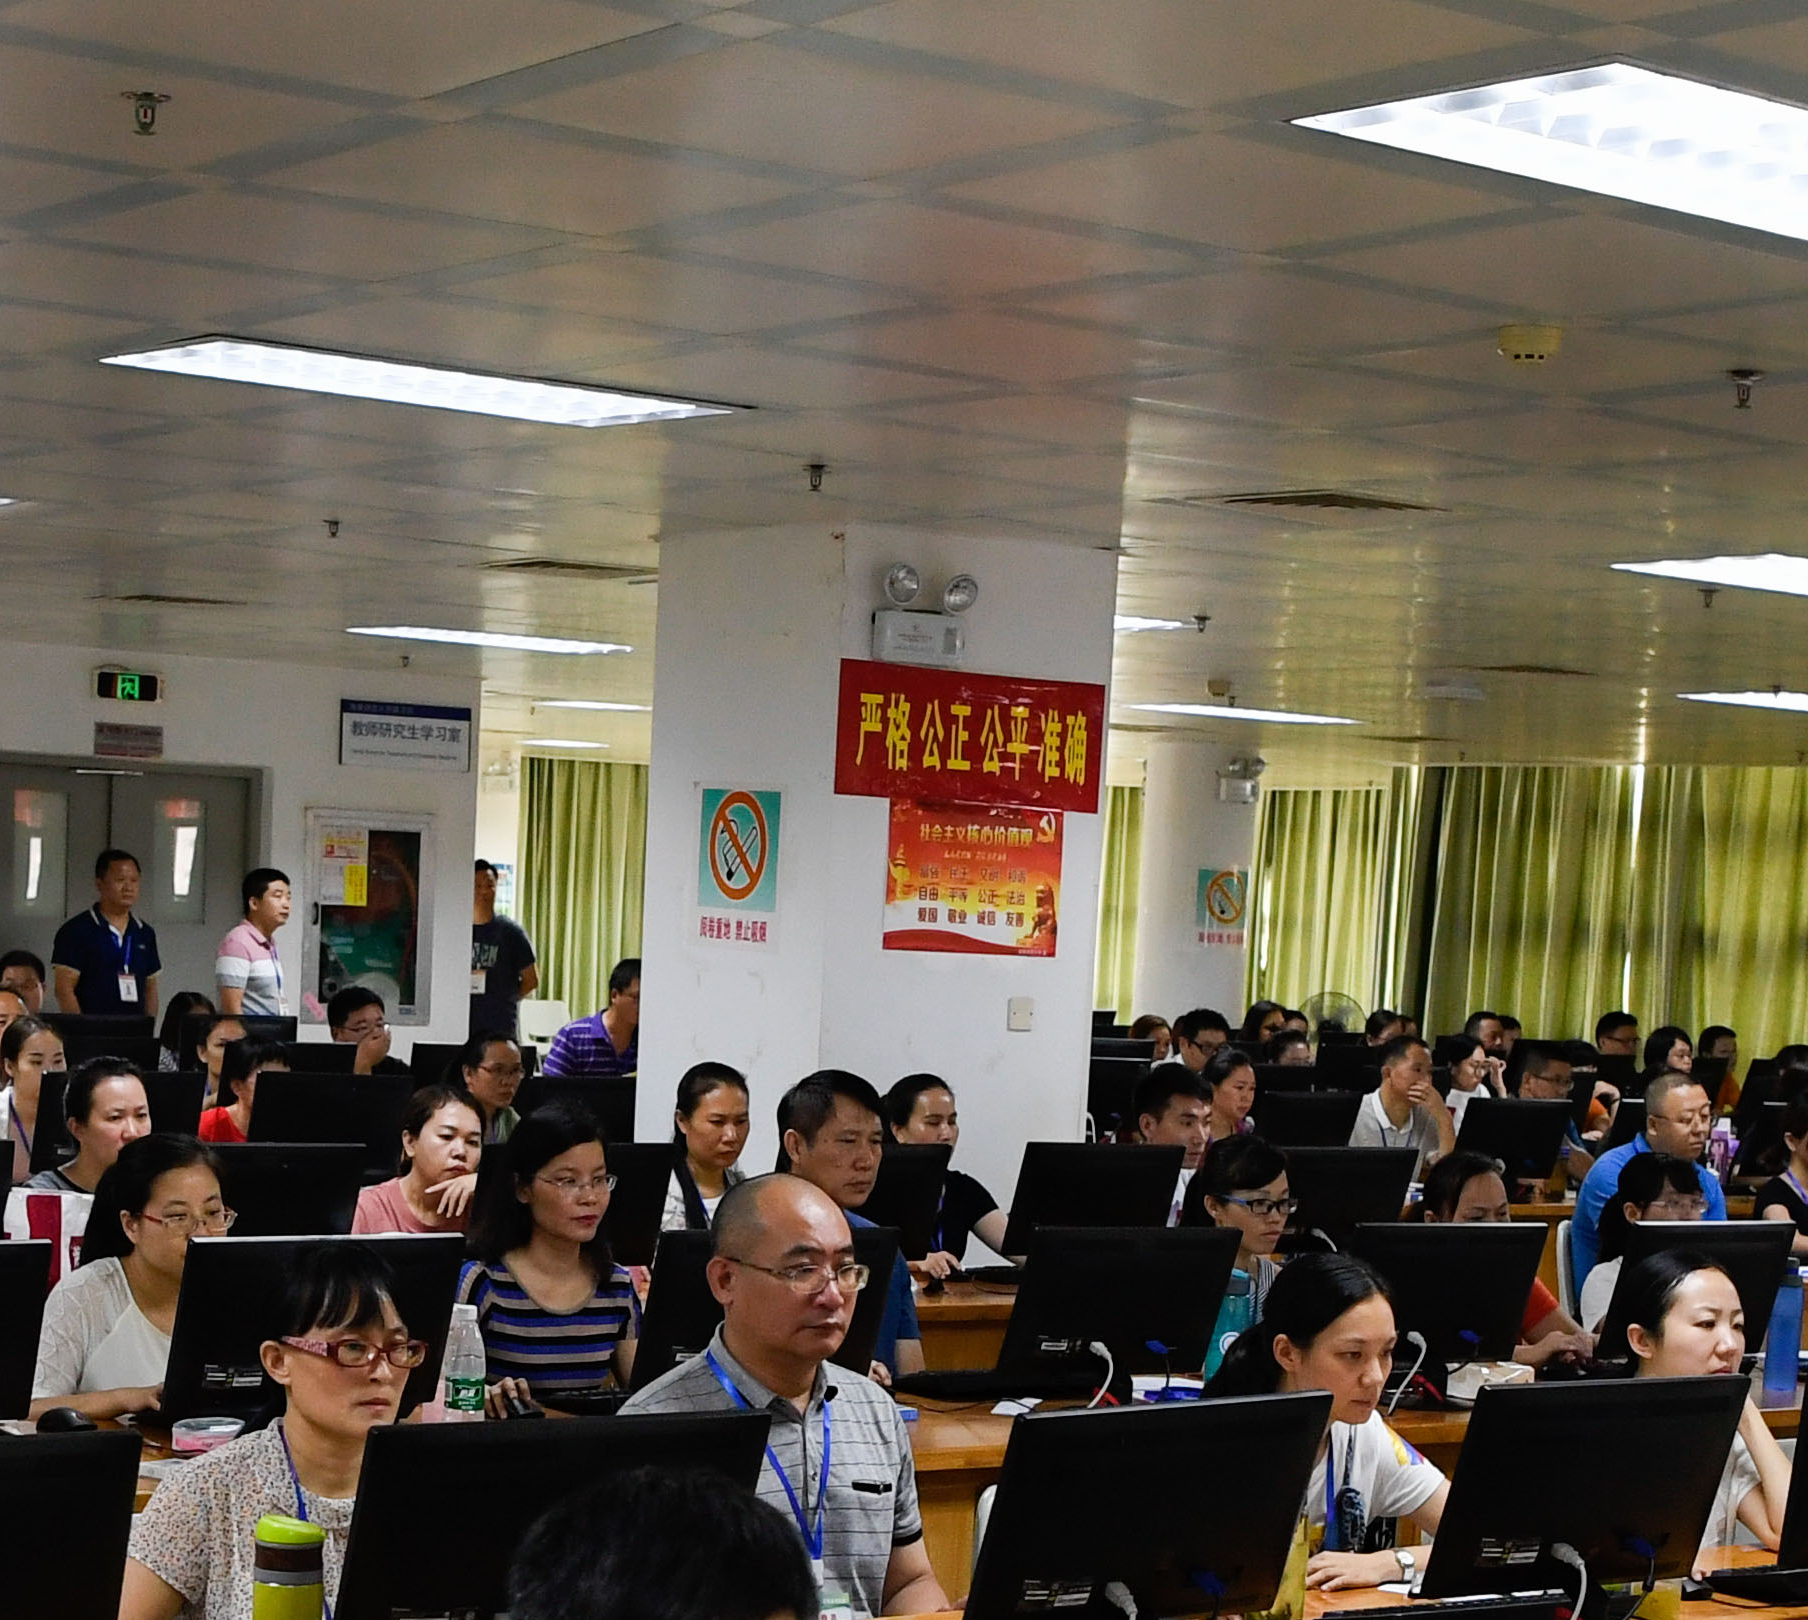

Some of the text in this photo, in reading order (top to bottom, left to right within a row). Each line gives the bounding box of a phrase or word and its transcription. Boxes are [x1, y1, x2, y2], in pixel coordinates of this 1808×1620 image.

[855, 692, 1087, 786] 严格 公正 公平 准确
[918, 887, 938, 901] 自由
[978, 888, 999, 905] 公正
